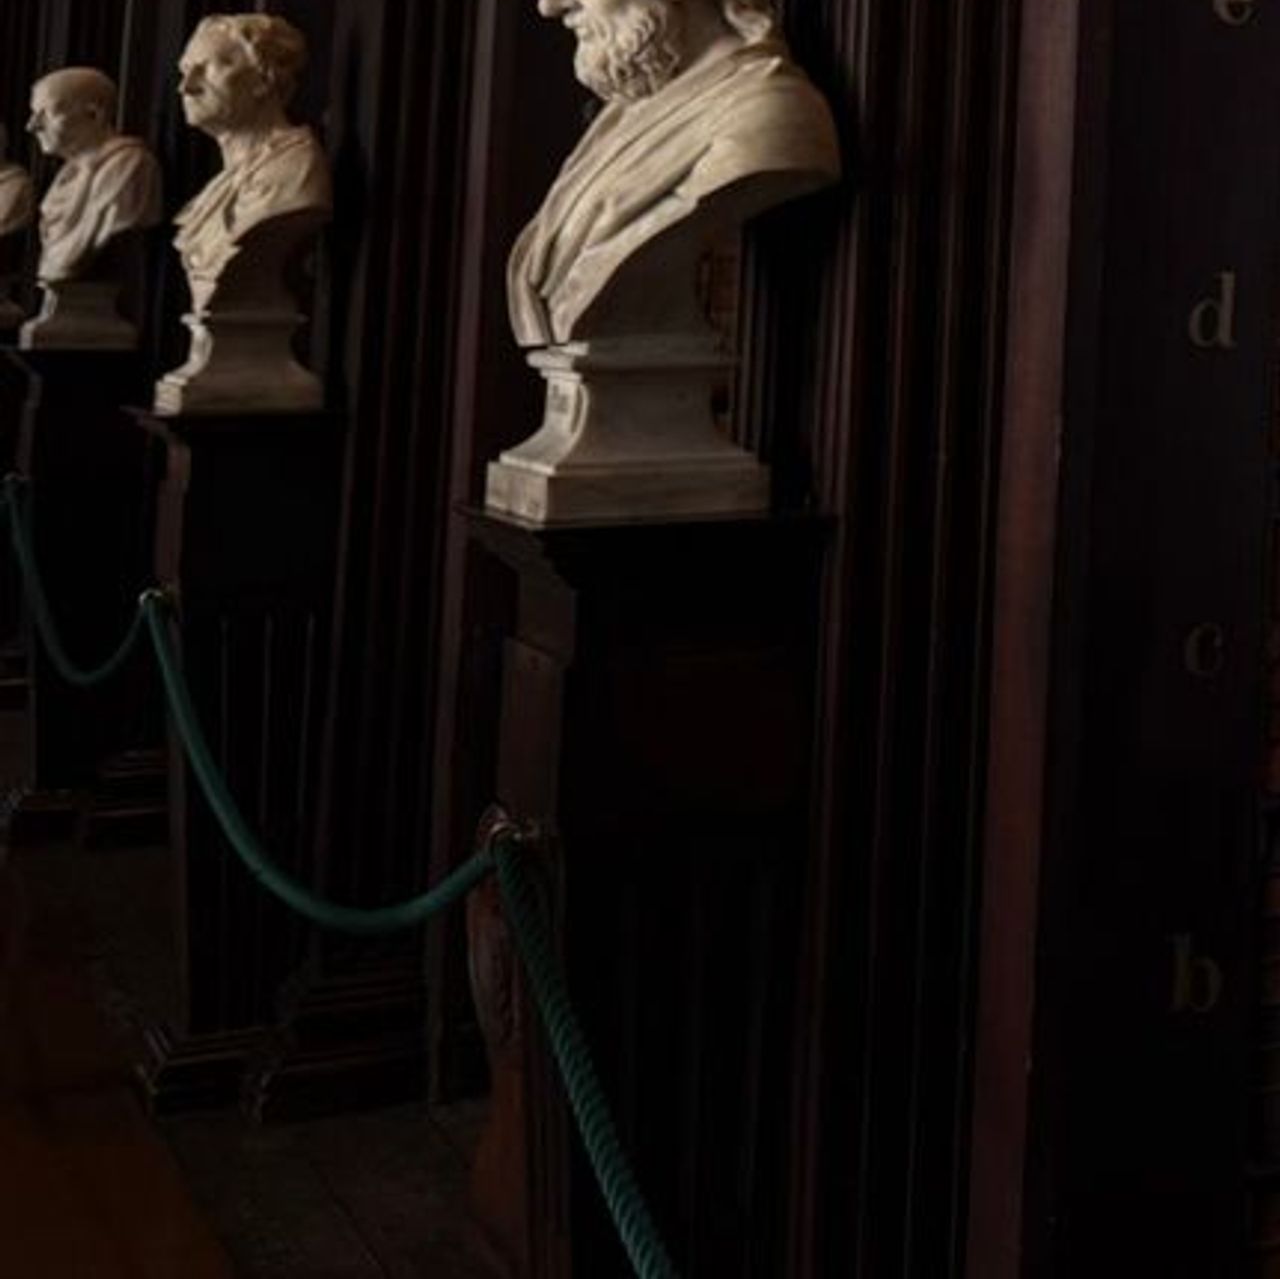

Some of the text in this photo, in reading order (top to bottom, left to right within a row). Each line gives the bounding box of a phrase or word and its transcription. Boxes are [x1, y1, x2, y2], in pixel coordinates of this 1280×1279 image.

[1188, 270, 1238, 350] d
[1184, 622, 1225, 677] c
[1165, 931, 1222, 1013] b
